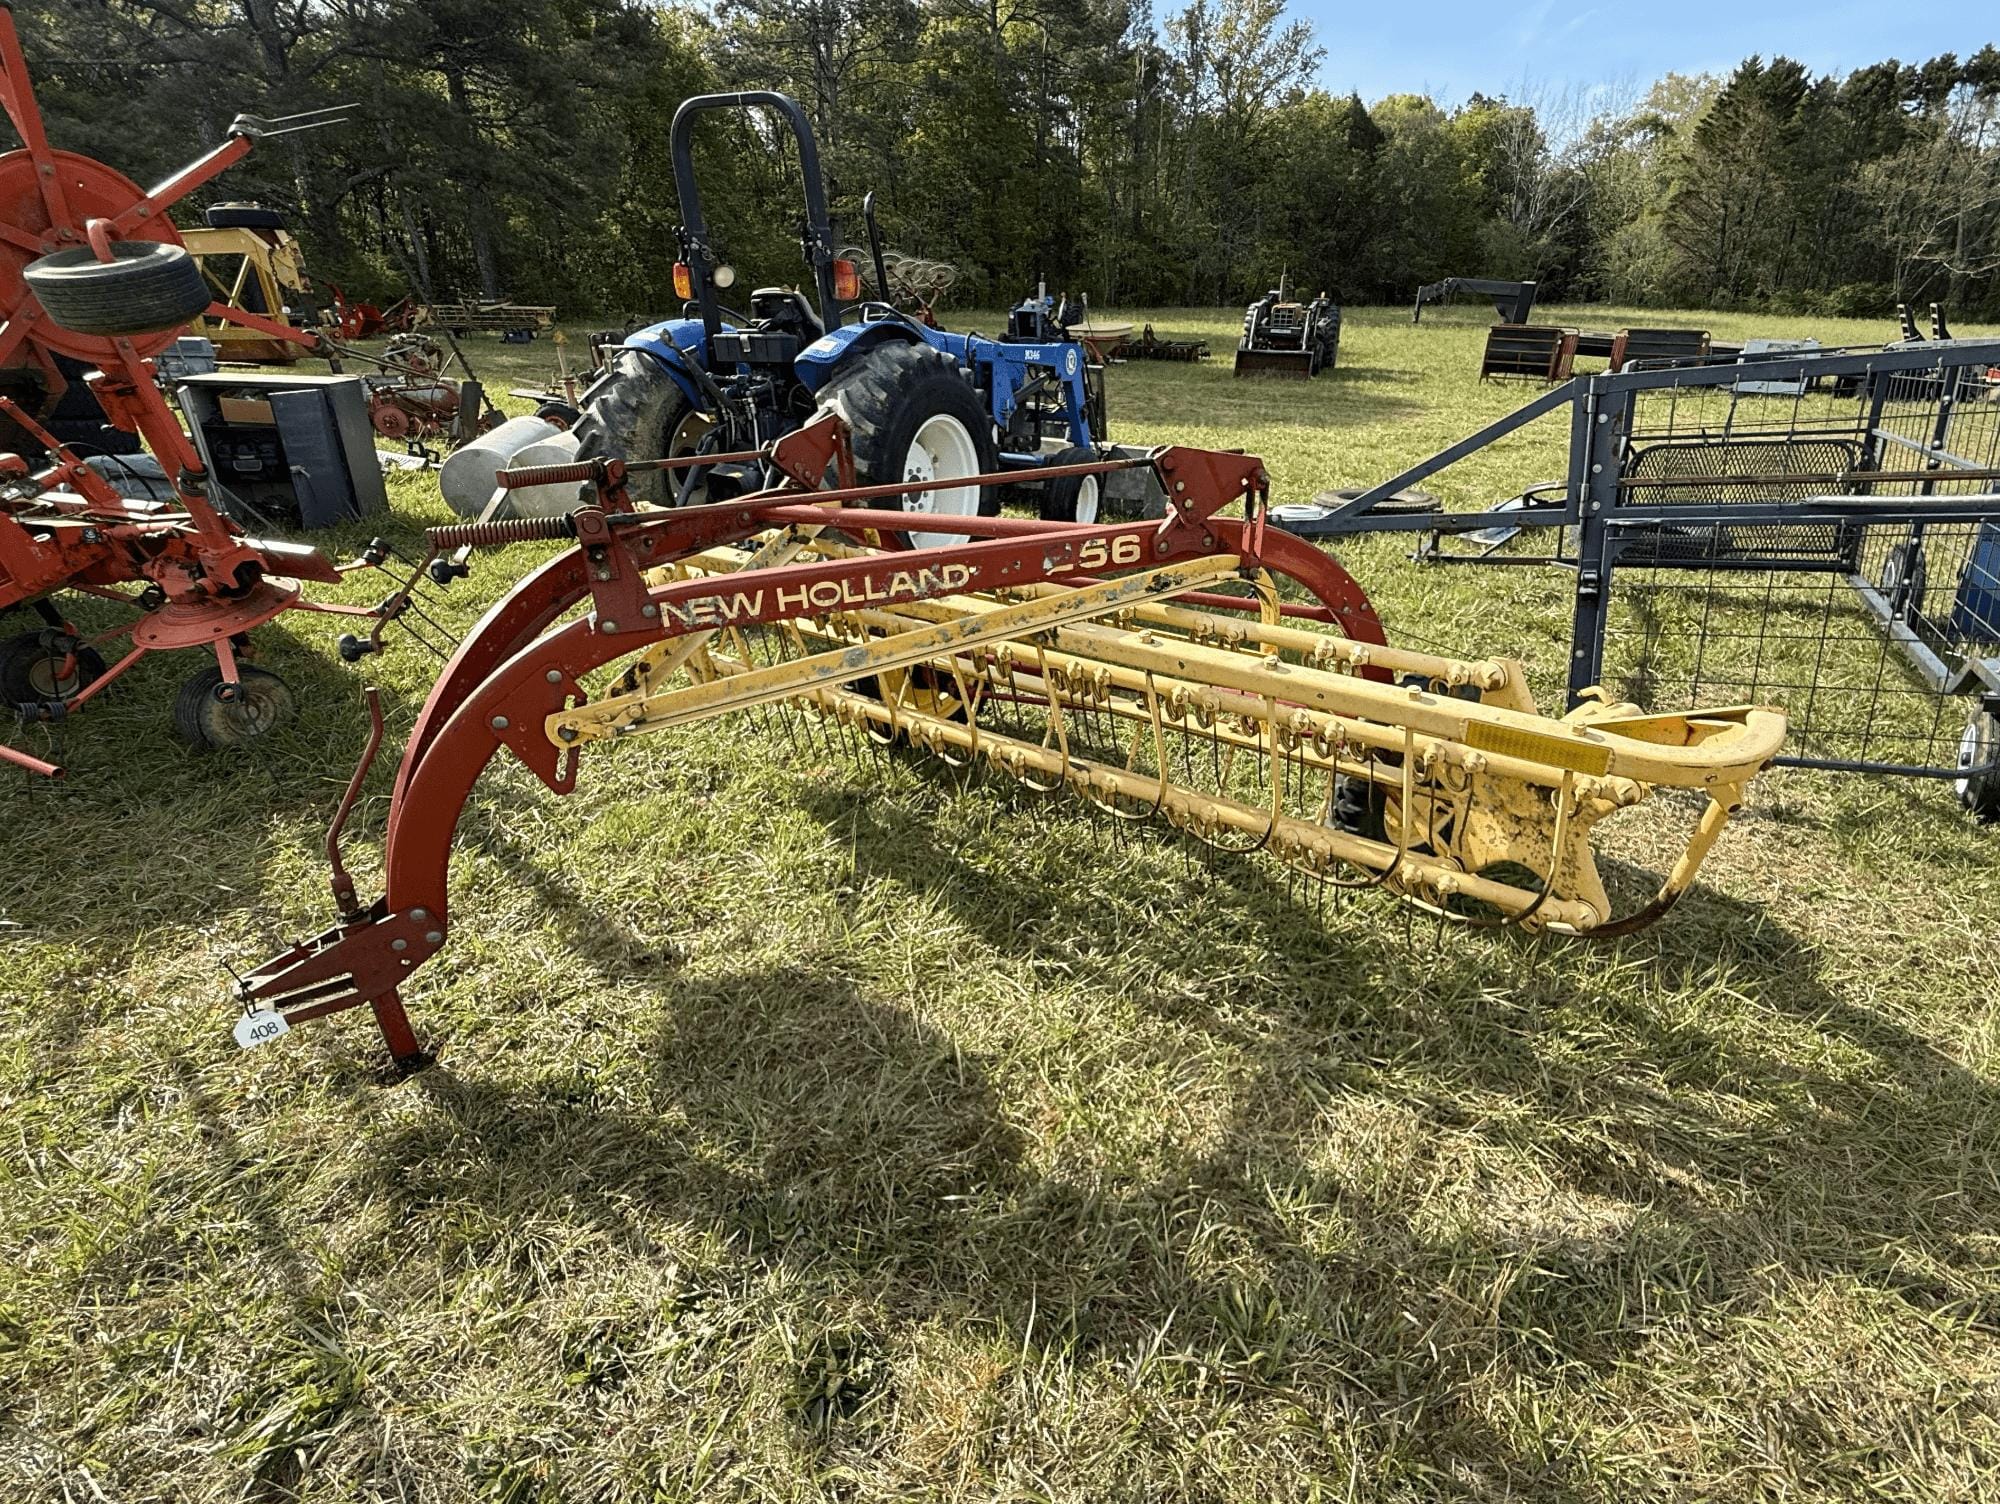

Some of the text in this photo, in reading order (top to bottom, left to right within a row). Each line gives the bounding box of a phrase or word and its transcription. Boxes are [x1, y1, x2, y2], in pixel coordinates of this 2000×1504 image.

[659, 589, 764, 628] NEW
[777, 565, 970, 612] HOLLAND
[250, 1021, 279, 1040] 408
